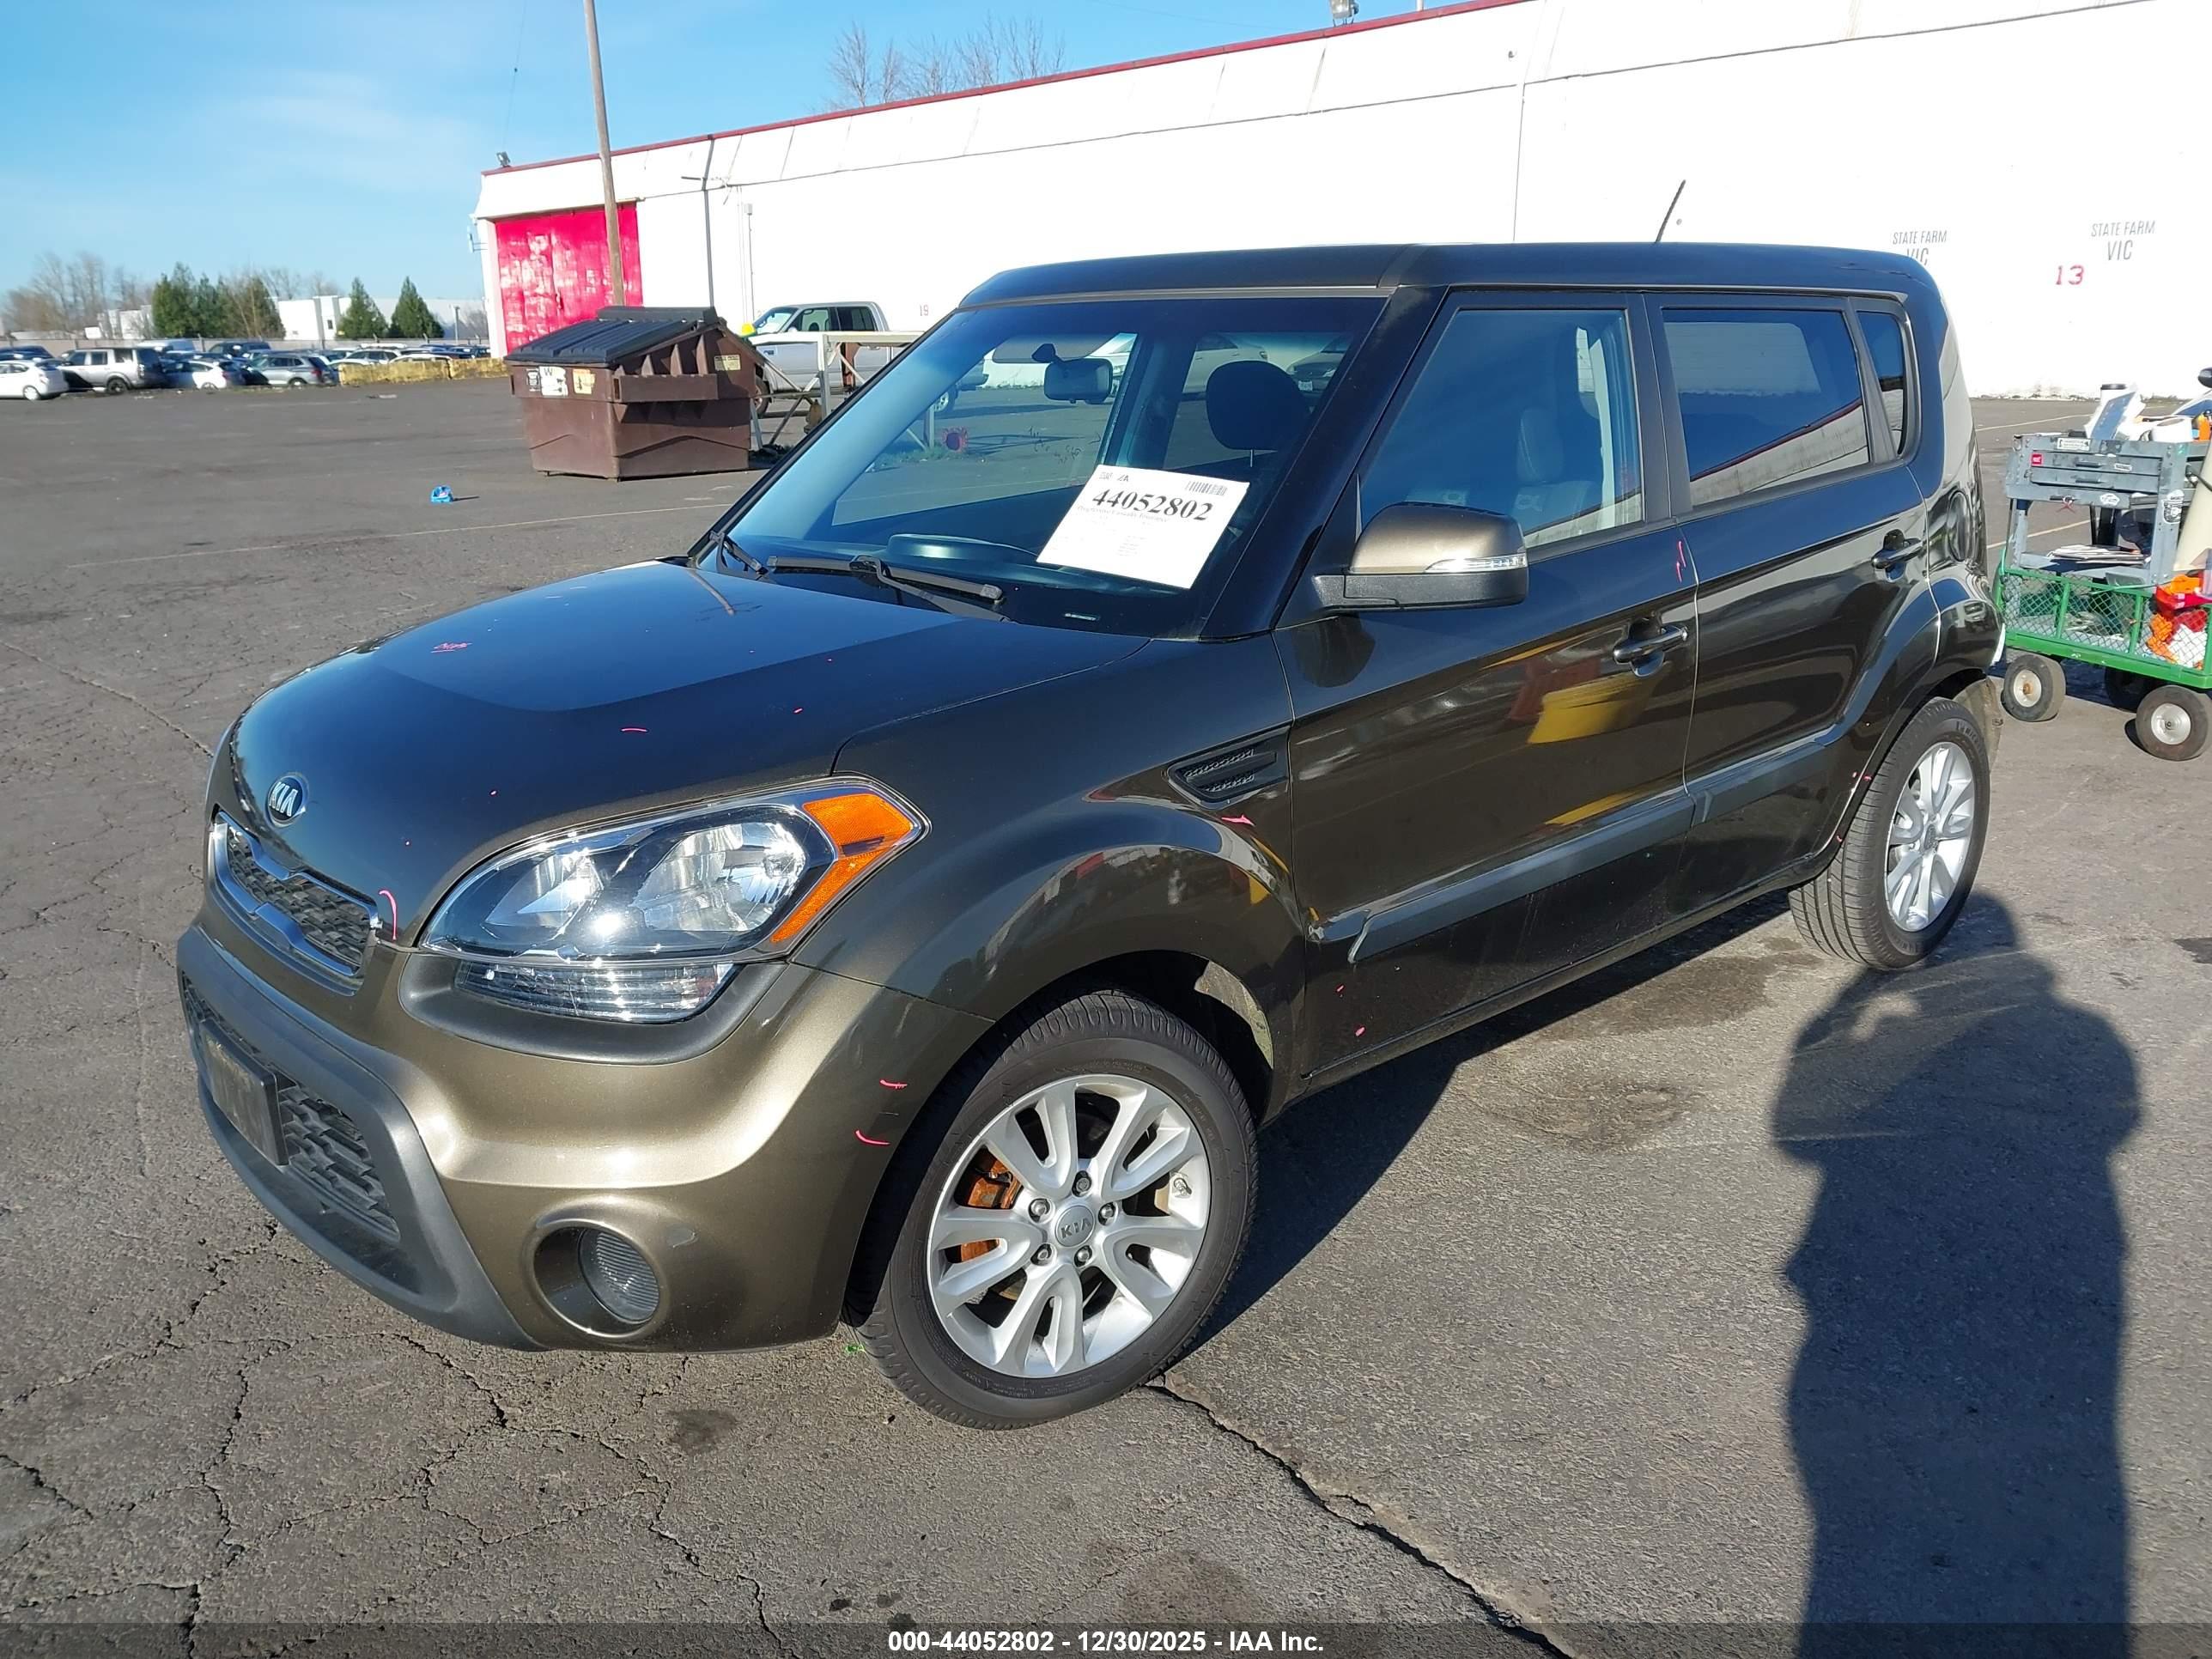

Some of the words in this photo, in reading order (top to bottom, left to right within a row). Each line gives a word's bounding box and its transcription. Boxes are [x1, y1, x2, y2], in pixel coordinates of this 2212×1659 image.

[1893, 231, 1918, 245] STATE
[1920, 230, 1948, 244] FARM
[2091, 222, 2121, 237] STATE
[2124, 220, 2155, 235] FARM
[2107, 240, 2133, 261] VIC
[2056, 264, 2084, 285] 13
[1091, 489, 1213, 521] 44052802
[268, 781, 299, 817] KIA
[1060, 1218, 1092, 1238] KIA
